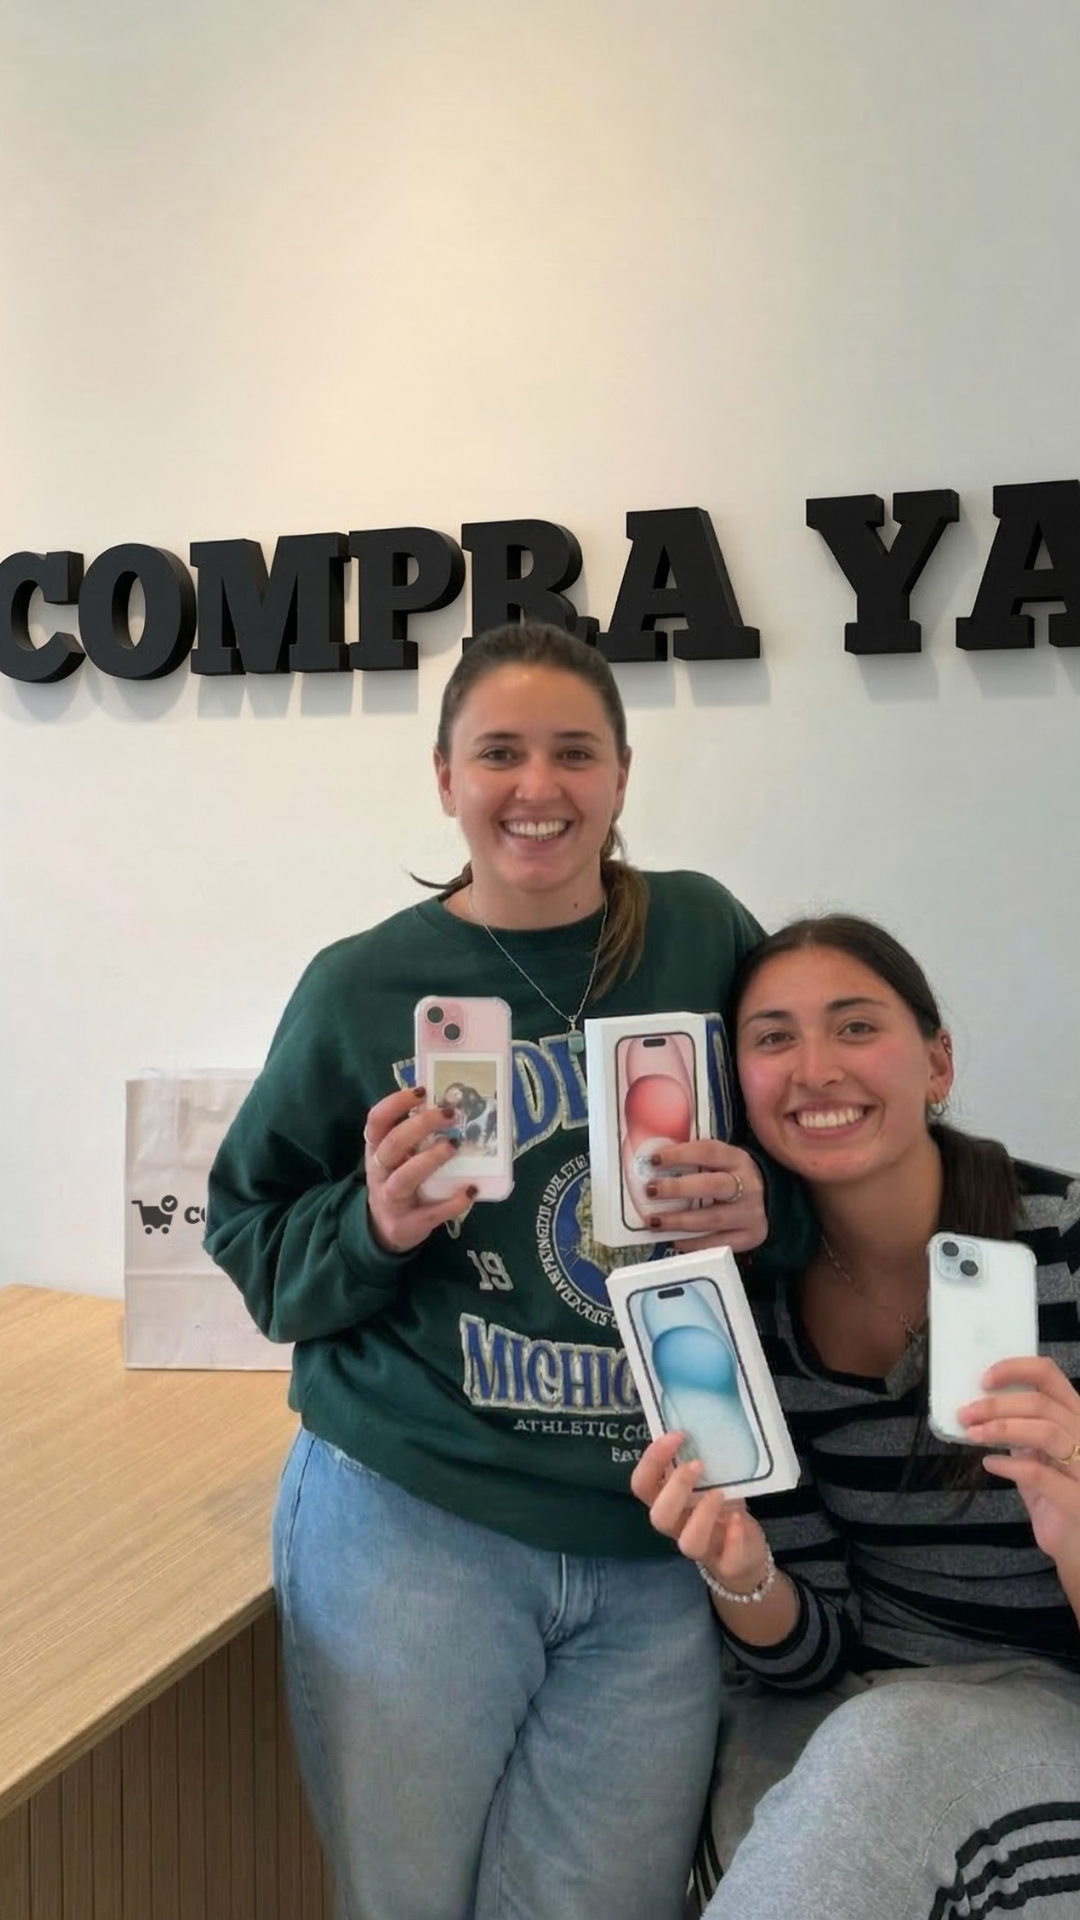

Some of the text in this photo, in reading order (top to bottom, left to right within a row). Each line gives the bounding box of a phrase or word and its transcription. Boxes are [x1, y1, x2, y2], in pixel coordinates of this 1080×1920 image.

[0, 479, 1080, 683] COMPRA YA
[466, 1249, 515, 1292] 19
